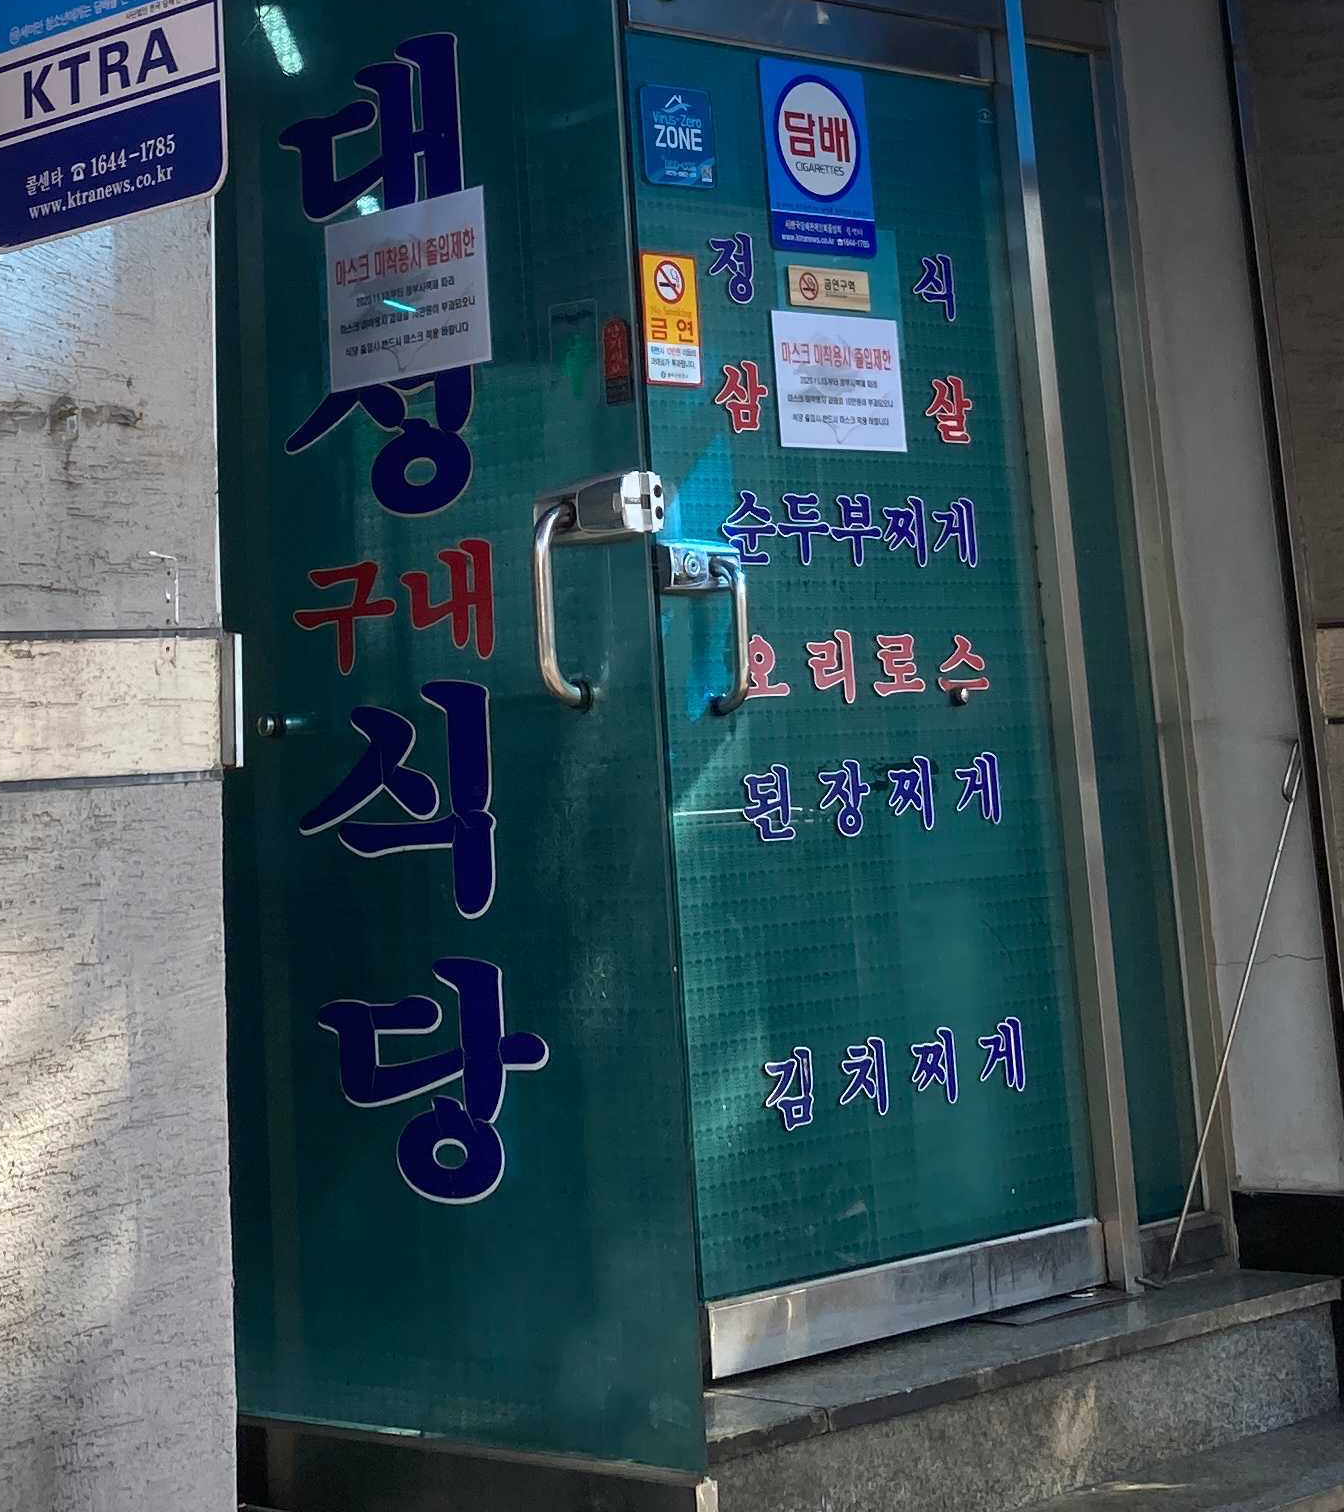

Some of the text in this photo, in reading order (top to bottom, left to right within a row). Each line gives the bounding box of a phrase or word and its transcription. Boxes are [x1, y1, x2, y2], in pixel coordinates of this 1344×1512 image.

[23, 27, 178, 120] KTRA
[25, 133, 176, 196] 콜센타 1644-1785
[654, 124, 703, 151] ZONE
[784, 110, 850, 163] 담배
[795, 161, 845, 177] CIGARETTES
[28, 164, 174, 220] www.ktranews.co.kr
[335, 254, 370, 287] 마스크
[374, 240, 422, 279] 미착용시
[782, 342, 810, 364] 마스크
[814, 344, 851, 368] 미착용시
[722, 490, 978, 568] 순두부찌게
[293, 538, 495, 675] 구내
[746, 630, 989, 704] 오리로스
[743, 752, 1002, 841] 된장찌게
[297, 679, 549, 1205] 식당
[765, 1016, 1026, 1131] 김치찌게
